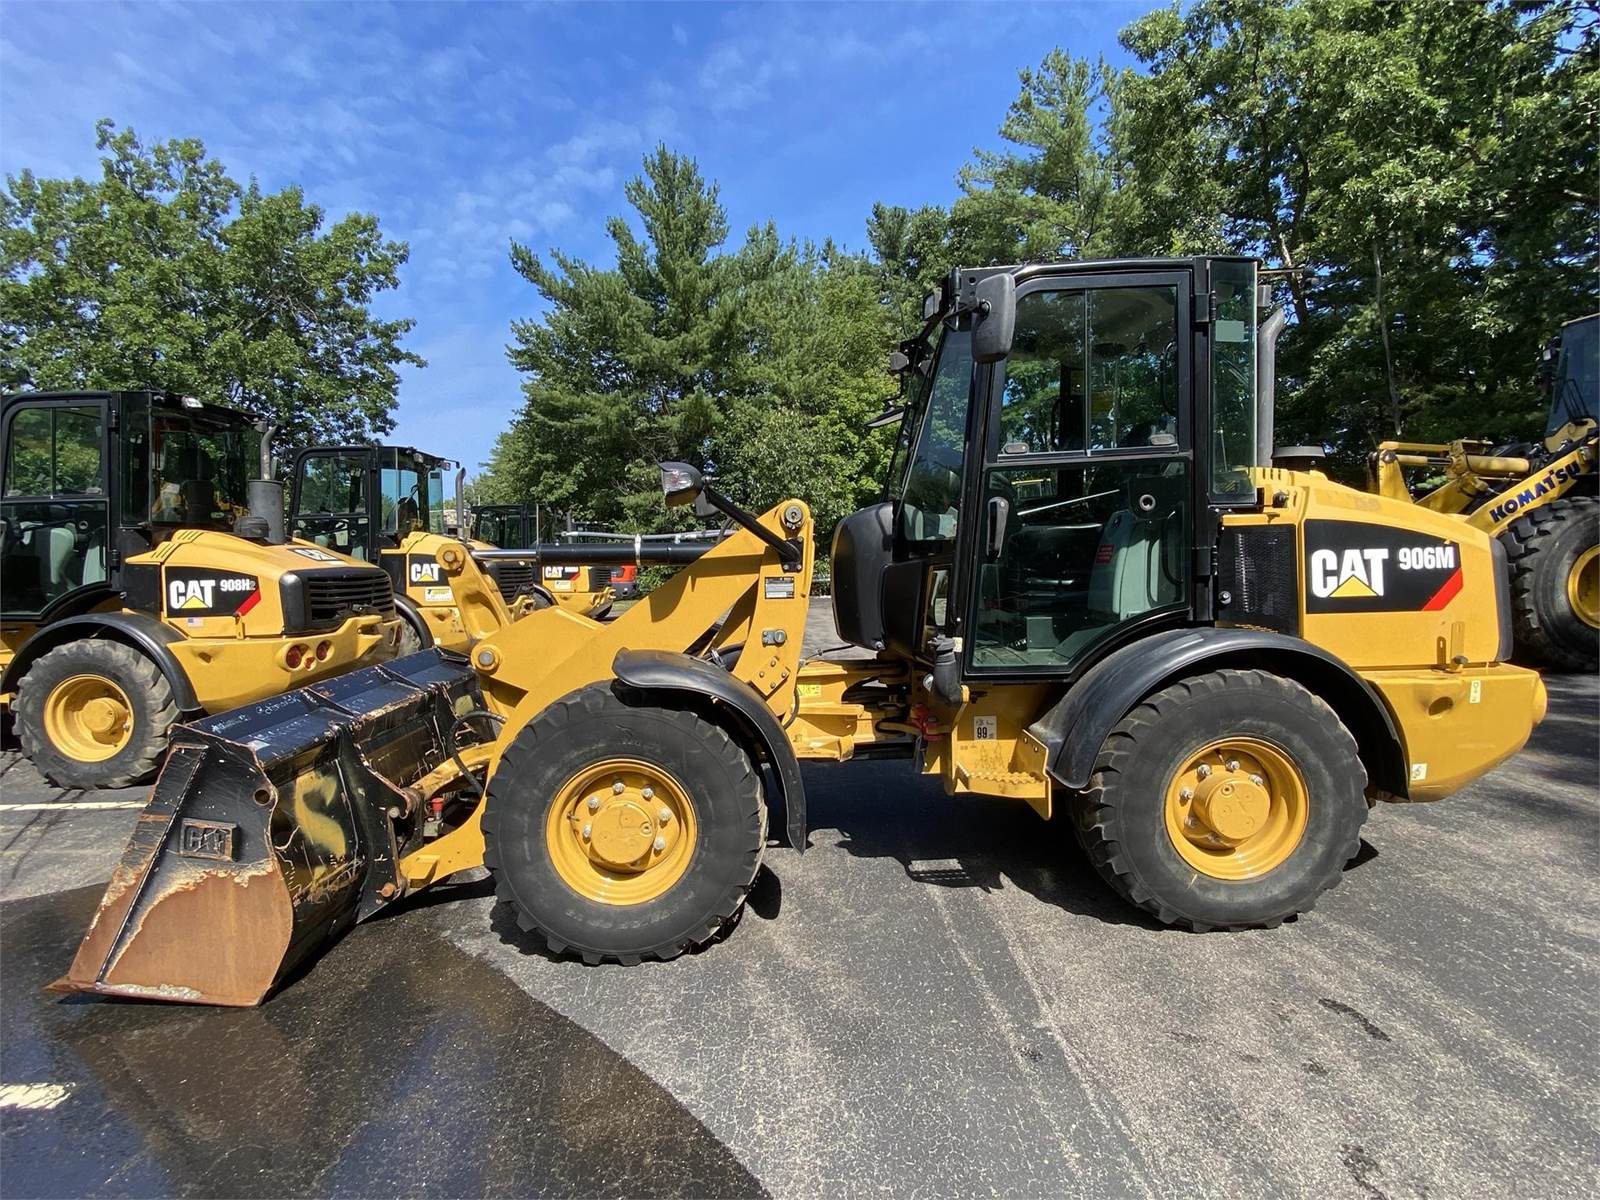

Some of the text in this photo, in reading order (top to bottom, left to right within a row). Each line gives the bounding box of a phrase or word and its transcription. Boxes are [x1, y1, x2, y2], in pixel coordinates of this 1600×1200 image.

[1489, 461, 1581, 523] KOMATSU
[411, 563, 441, 582] CAT
[545, 566, 563, 578] CAT
[1311, 547, 1455, 598] CAT 906M
[169, 580, 216, 609] CAT
[977, 727, 987, 738] 99
